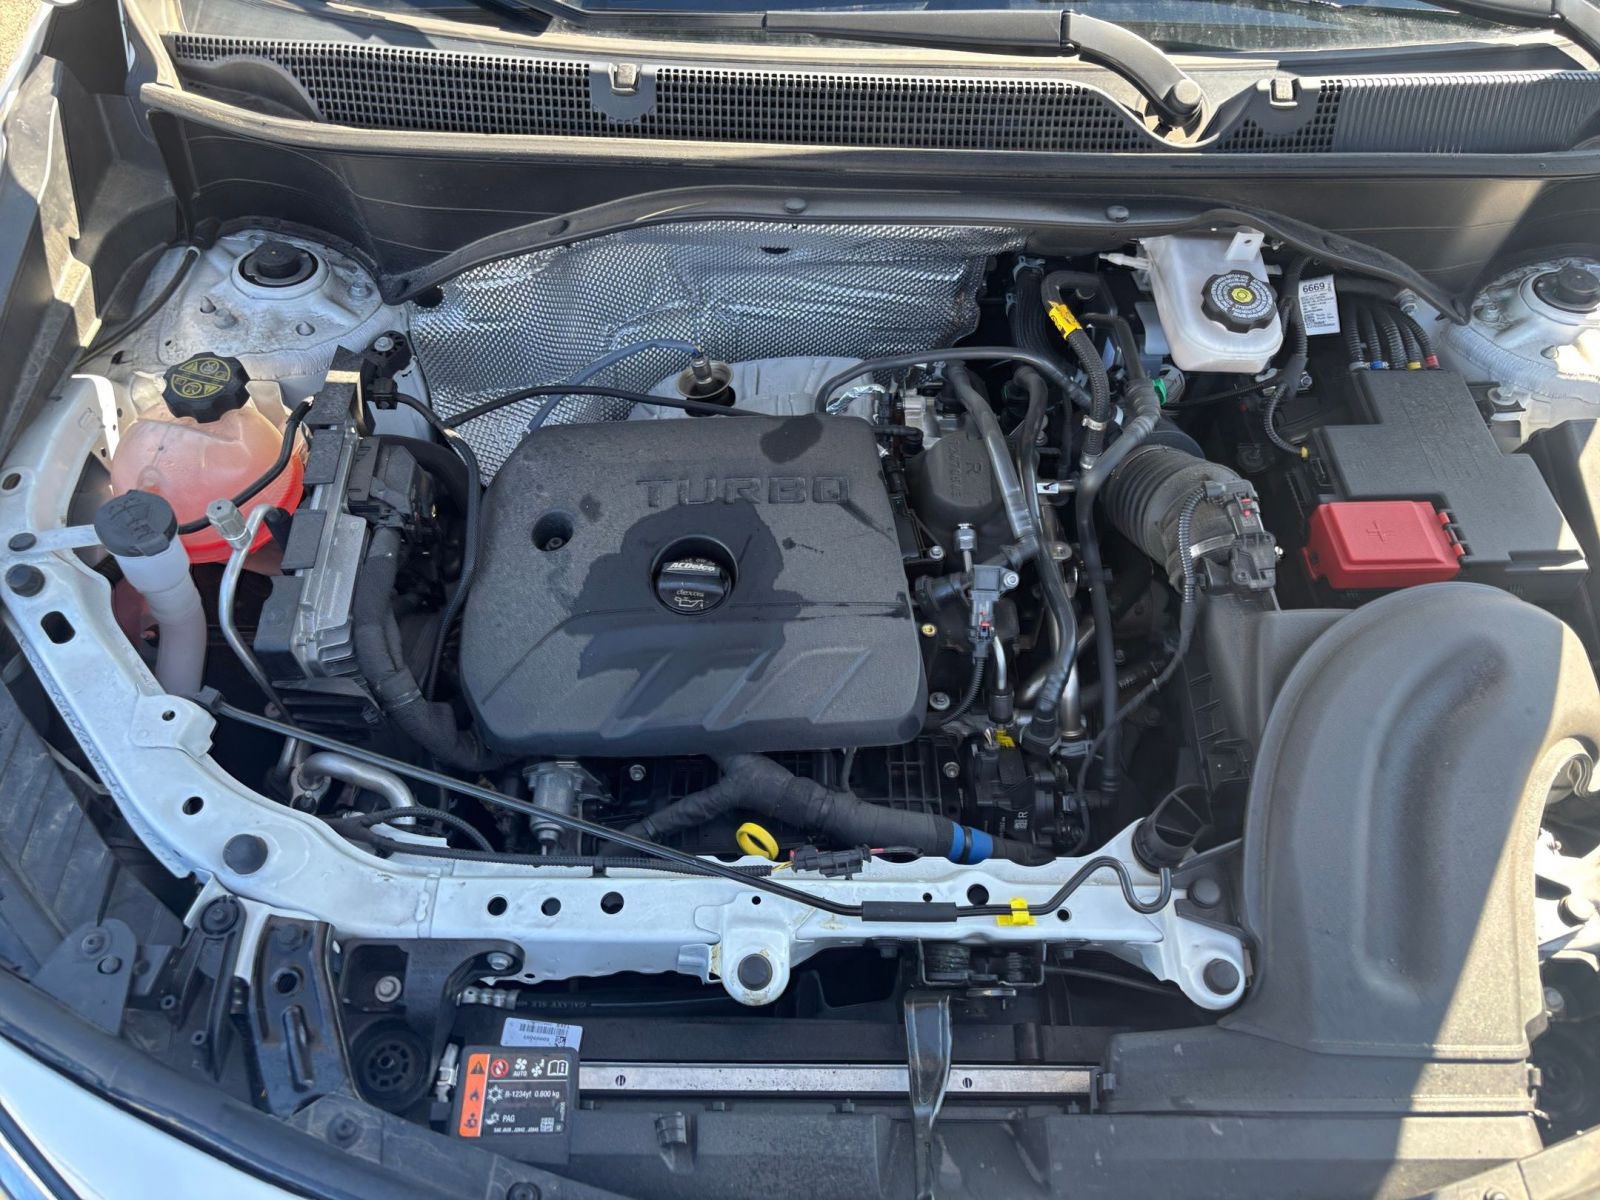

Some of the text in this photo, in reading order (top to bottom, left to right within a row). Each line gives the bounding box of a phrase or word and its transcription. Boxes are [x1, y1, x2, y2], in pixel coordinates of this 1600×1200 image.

[1303, 282, 1325, 293] 6669
[636, 476, 848, 507] TURBO
[671, 562, 716, 571] ACDelco
[552, 1090, 560, 1099] kg
[502, 1114, 516, 1122] PAG
